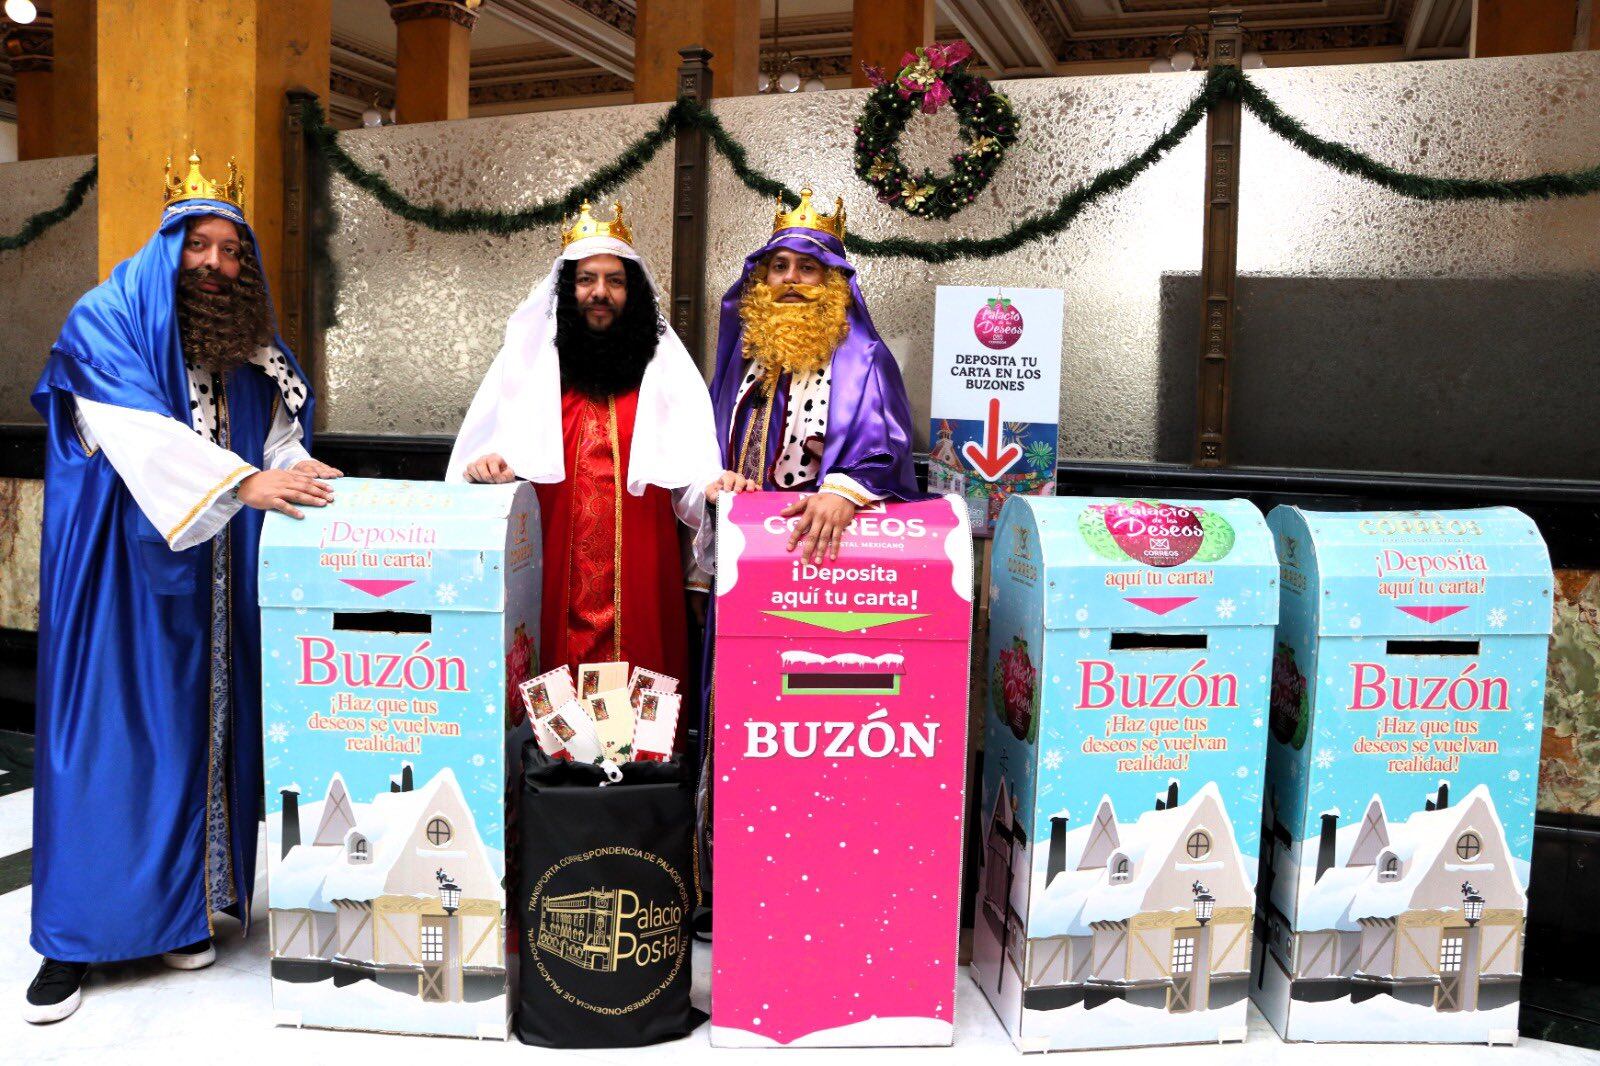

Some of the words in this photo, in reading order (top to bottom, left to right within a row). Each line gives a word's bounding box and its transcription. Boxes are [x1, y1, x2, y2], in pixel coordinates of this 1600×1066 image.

[977, 320, 1022, 334] Deseos
[955, 354, 1016, 366] DEPOSITA
[1021, 357, 1037, 367] TU
[950, 366, 991, 377] CARTA
[996, 368, 1012, 378] EN
[1016, 369, 1041, 379] LOS
[966, 379, 1025, 391] BUZONES
[320, 521, 436, 549] ¡Deposita
[763, 515, 926, 538] COREOS
[1113, 517, 1203, 537] Deseos
[320, 550, 358, 571] aquí
[362, 552, 379, 567] tu
[383, 550, 432, 568] carta!
[1376, 549, 1488, 578] ¡Deposita
[792, 560, 897, 585] ¡Deposita
[1105, 570, 1141, 590] aquí
[1147, 571, 1163, 585] tu
[1167, 570, 1214, 585] carta!
[771, 587, 818, 608] aquí
[825, 589, 847, 605] tu
[853, 589, 918, 610] carta!
[1379, 578, 1415, 599] aquí
[1419, 580, 1435, 594] tu
[1438, 577, 1486, 594] carta!
[296, 636, 469, 692] Buzón
[1074, 659, 1239, 710] Buzón
[1347, 662, 1510, 711] Buzón
[330, 693, 372, 714] ¡Haz
[376, 698, 407, 717] que
[412, 698, 438, 713] tus
[308, 713, 366, 731] deseos
[370, 719, 387, 732] se
[392, 718, 460, 736] vuelvan
[743, 708, 941, 758] BUZÓN
[1106, 716, 1145, 736] ¡Haz
[1149, 718, 1179, 736] que
[1184, 717, 1208, 731] tus
[1377, 717, 1416, 738] ¡Haz
[1419, 720, 1450, 738] que
[1454, 718, 1478, 733] tus
[346, 735, 422, 753] realidad!
[1083, 737, 1137, 752] deseos
[1141, 740, 1158, 752] se
[1163, 736, 1227, 752] vuelvan
[1353, 738, 1407, 754] deseos
[1411, 740, 1429, 753] se
[1433, 738, 1498, 754] vuelvan
[1117, 754, 1189, 772] realidad!
[1387, 755, 1459, 773] realidad!
[528, 864, 561, 912] TRANSPORTA
[560, 846, 643, 867] CORRESPONDENCIA
[643, 852, 657, 863] DE
[656, 857, 681, 884] PALACIO
[678, 882, 690, 915] POSTAL
[616, 889, 682, 930] Palacio
[612, 927, 681, 972] Postal
[659, 935, 689, 989] TRANSPORTA
[536, 962, 563, 994] PALACIO
[562, 991, 576, 1003] DE
[576, 988, 661, 1016] CORRESPONDENCIA
